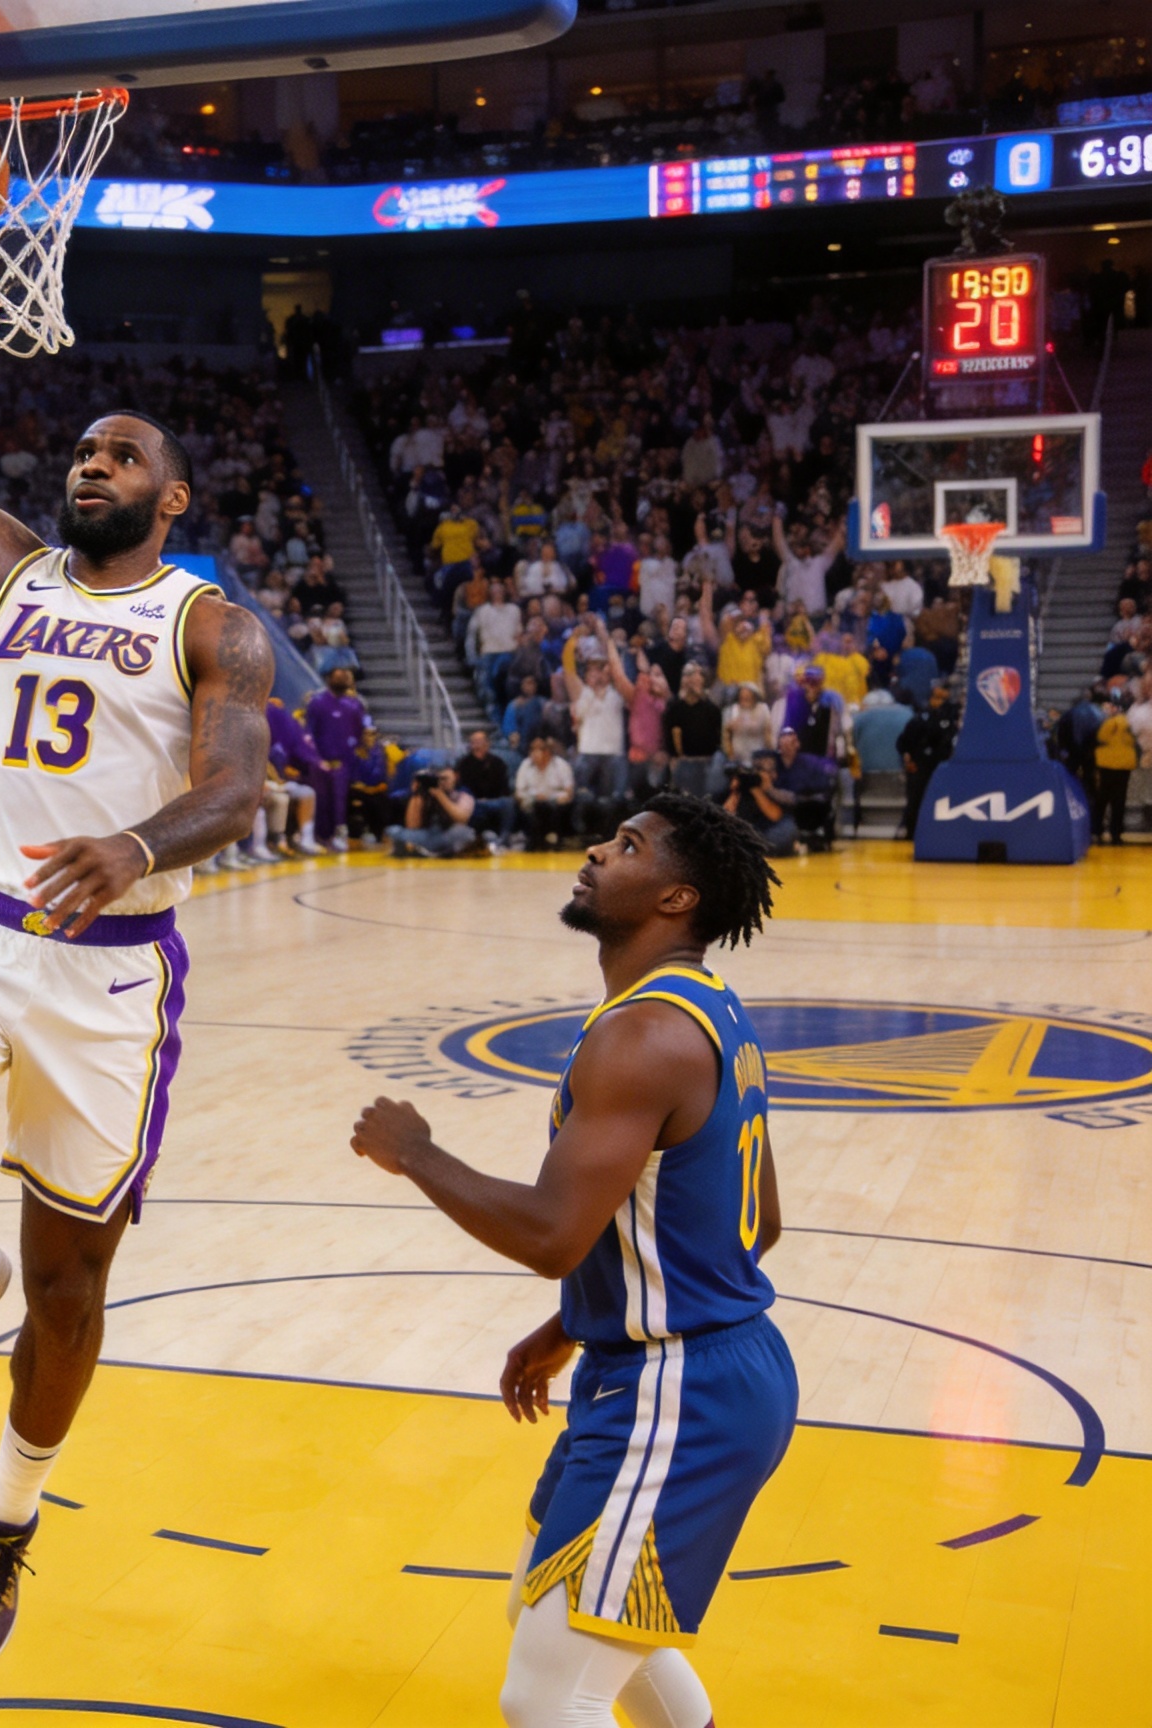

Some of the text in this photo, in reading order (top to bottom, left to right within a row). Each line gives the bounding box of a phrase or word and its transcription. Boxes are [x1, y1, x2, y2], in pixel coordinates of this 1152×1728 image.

[953, 300, 1020, 350] 20
[2, 672, 98, 775] 13
[934, 789, 1055, 822] KIA
